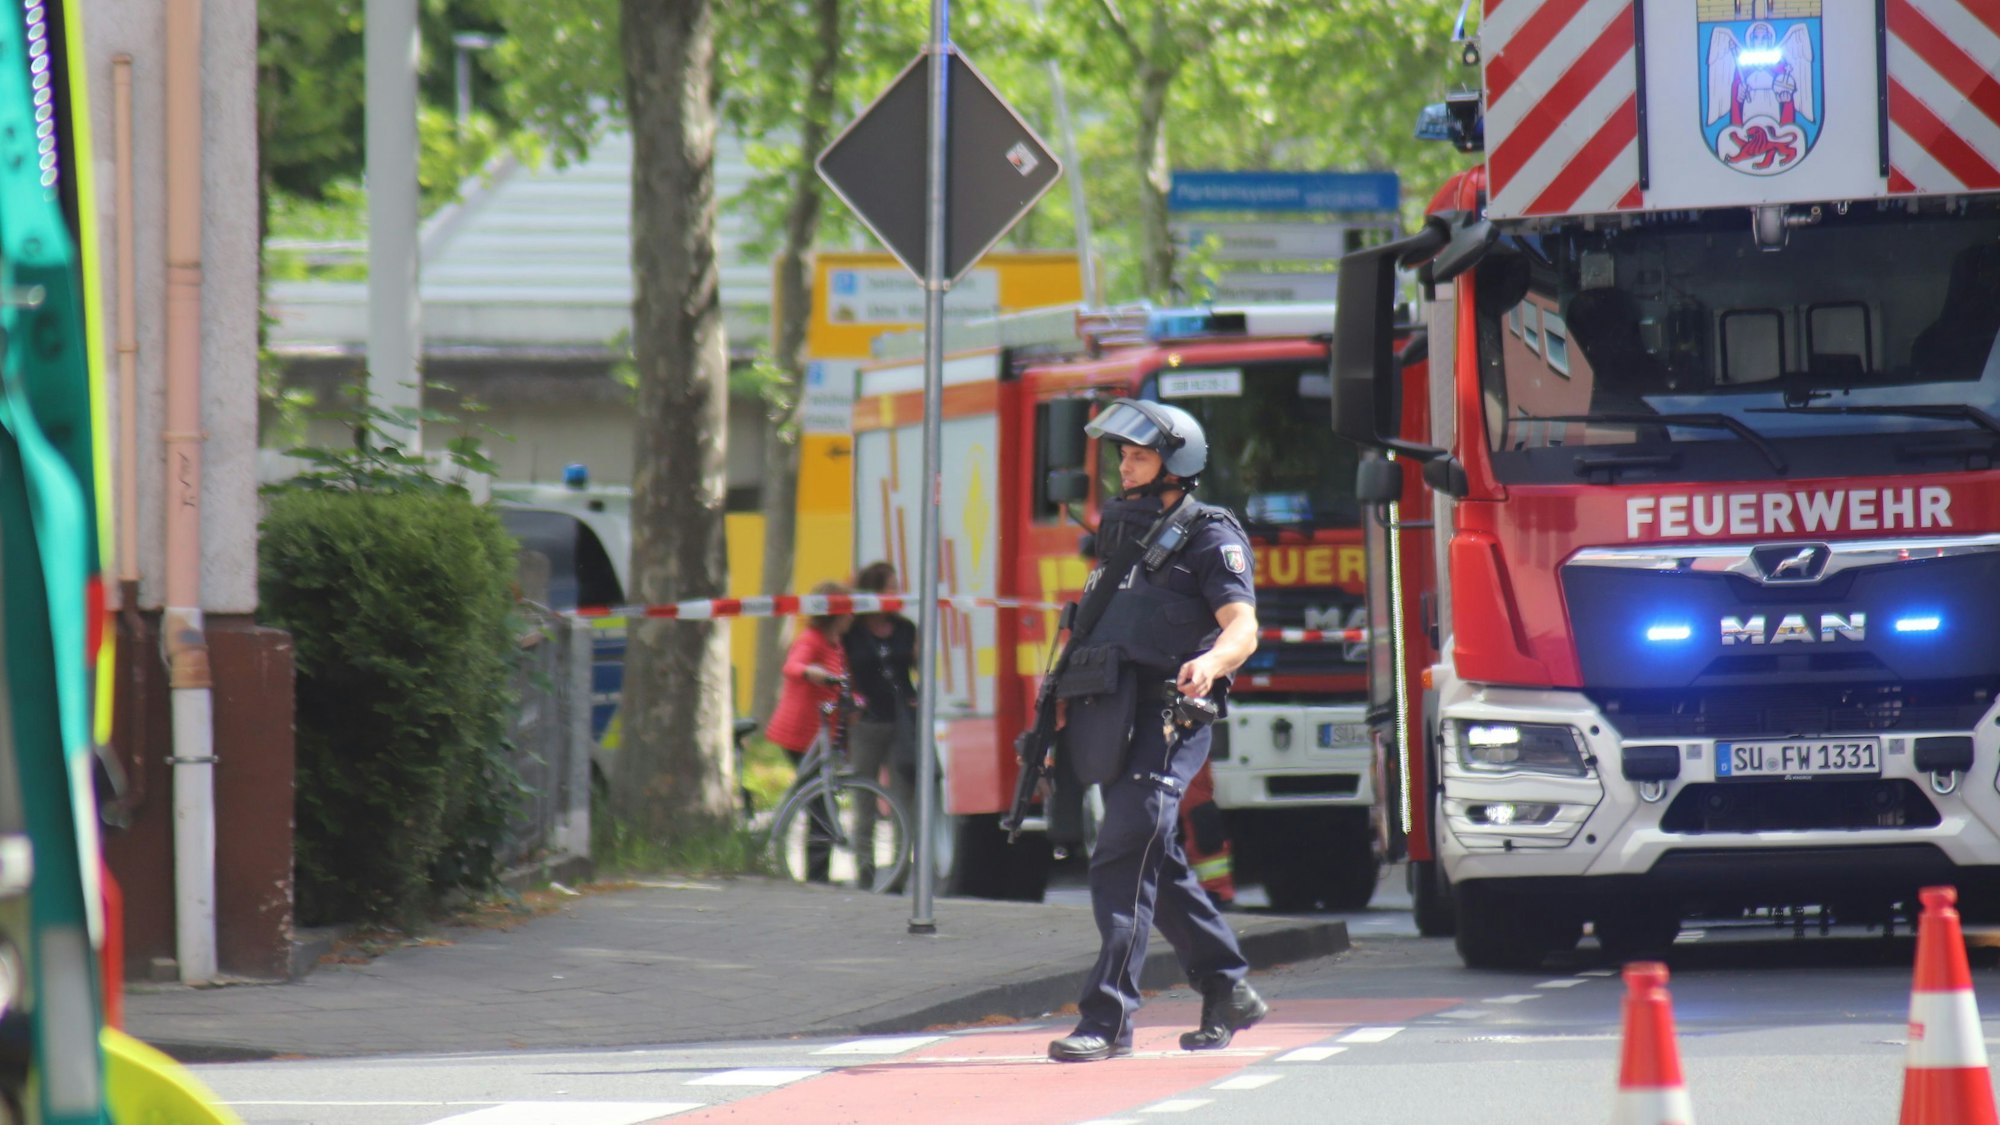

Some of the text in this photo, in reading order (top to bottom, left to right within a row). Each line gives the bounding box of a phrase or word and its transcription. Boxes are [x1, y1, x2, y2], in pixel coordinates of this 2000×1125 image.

[1626, 486, 1952, 539] FEUERWEHR
[1720, 613, 1866, 645] MAN
[1734, 747, 1763, 771] SU
[1781, 746, 1810, 770] FW
[1818, 744, 1876, 769] 1331
